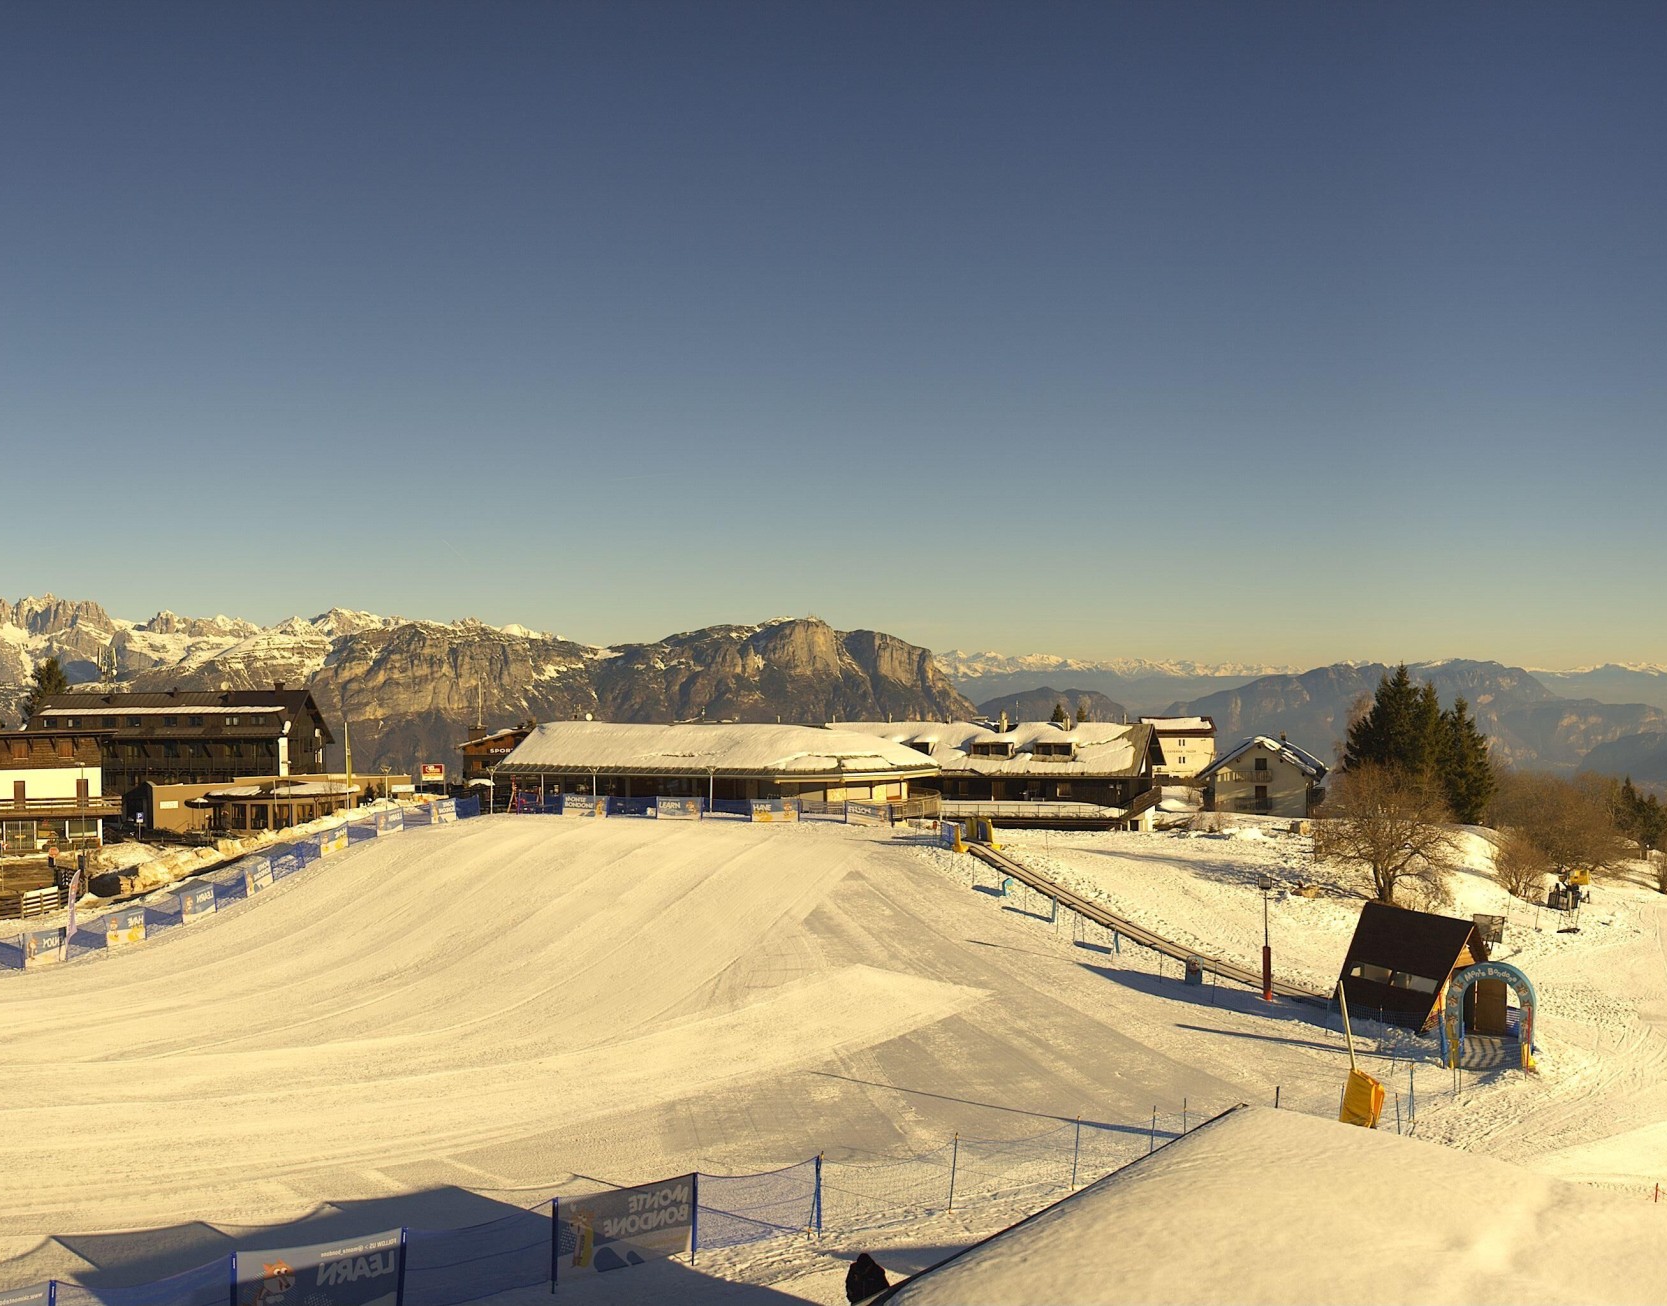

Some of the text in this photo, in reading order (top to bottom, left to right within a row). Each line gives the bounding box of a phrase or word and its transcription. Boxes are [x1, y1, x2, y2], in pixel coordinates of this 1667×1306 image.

[658, 800, 681, 809] LEARN
[1464, 967, 1518, 983] Monte Bondone
